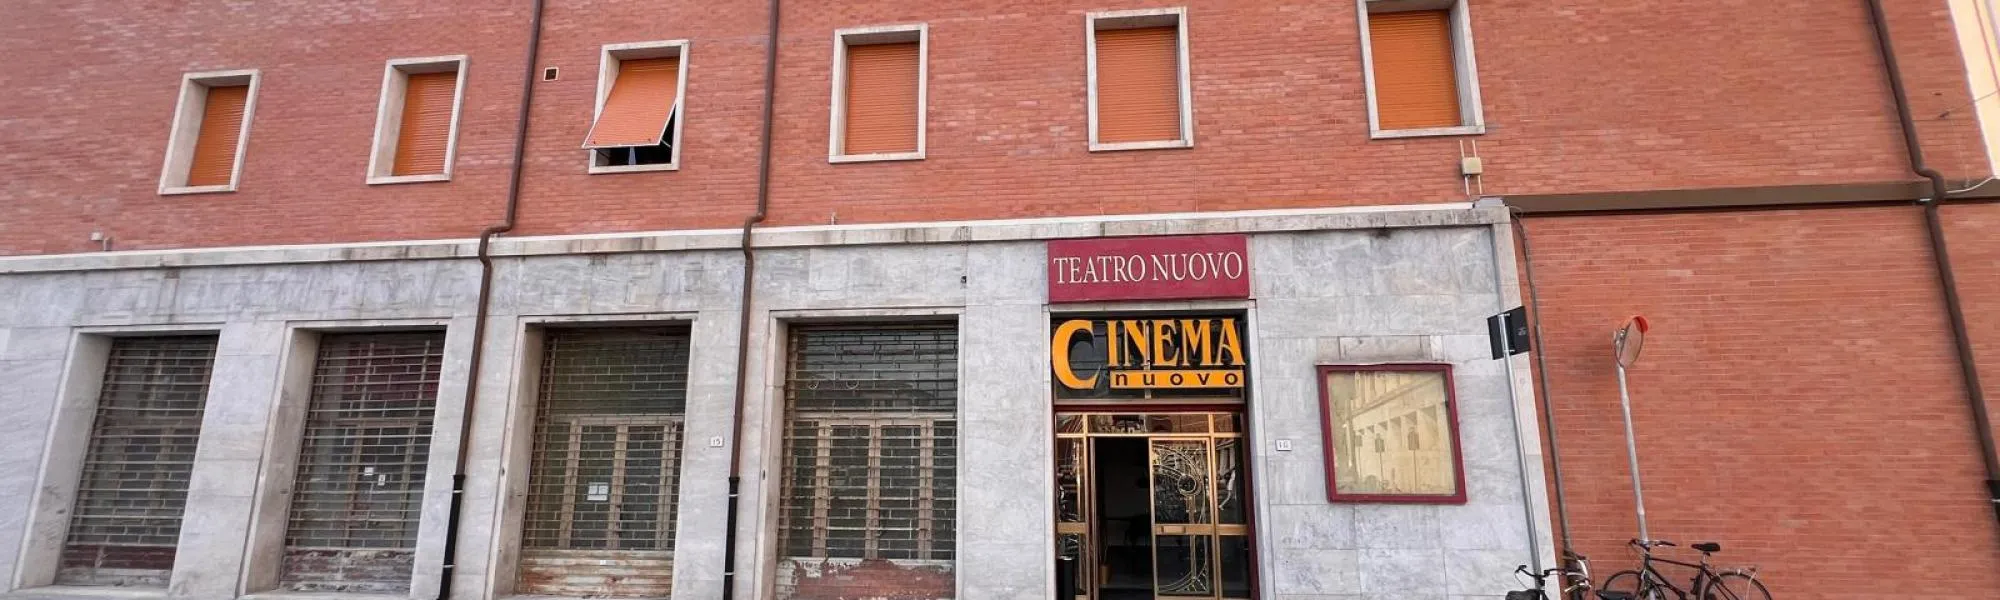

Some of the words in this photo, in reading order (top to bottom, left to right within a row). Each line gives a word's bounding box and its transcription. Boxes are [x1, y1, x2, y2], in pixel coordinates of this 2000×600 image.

[1053, 254, 1146, 284] TEATRO
[1151, 251, 1243, 281] NUOVO
[1052, 318, 1246, 390] CINEMA
[1115, 373, 1239, 386] nuovo
